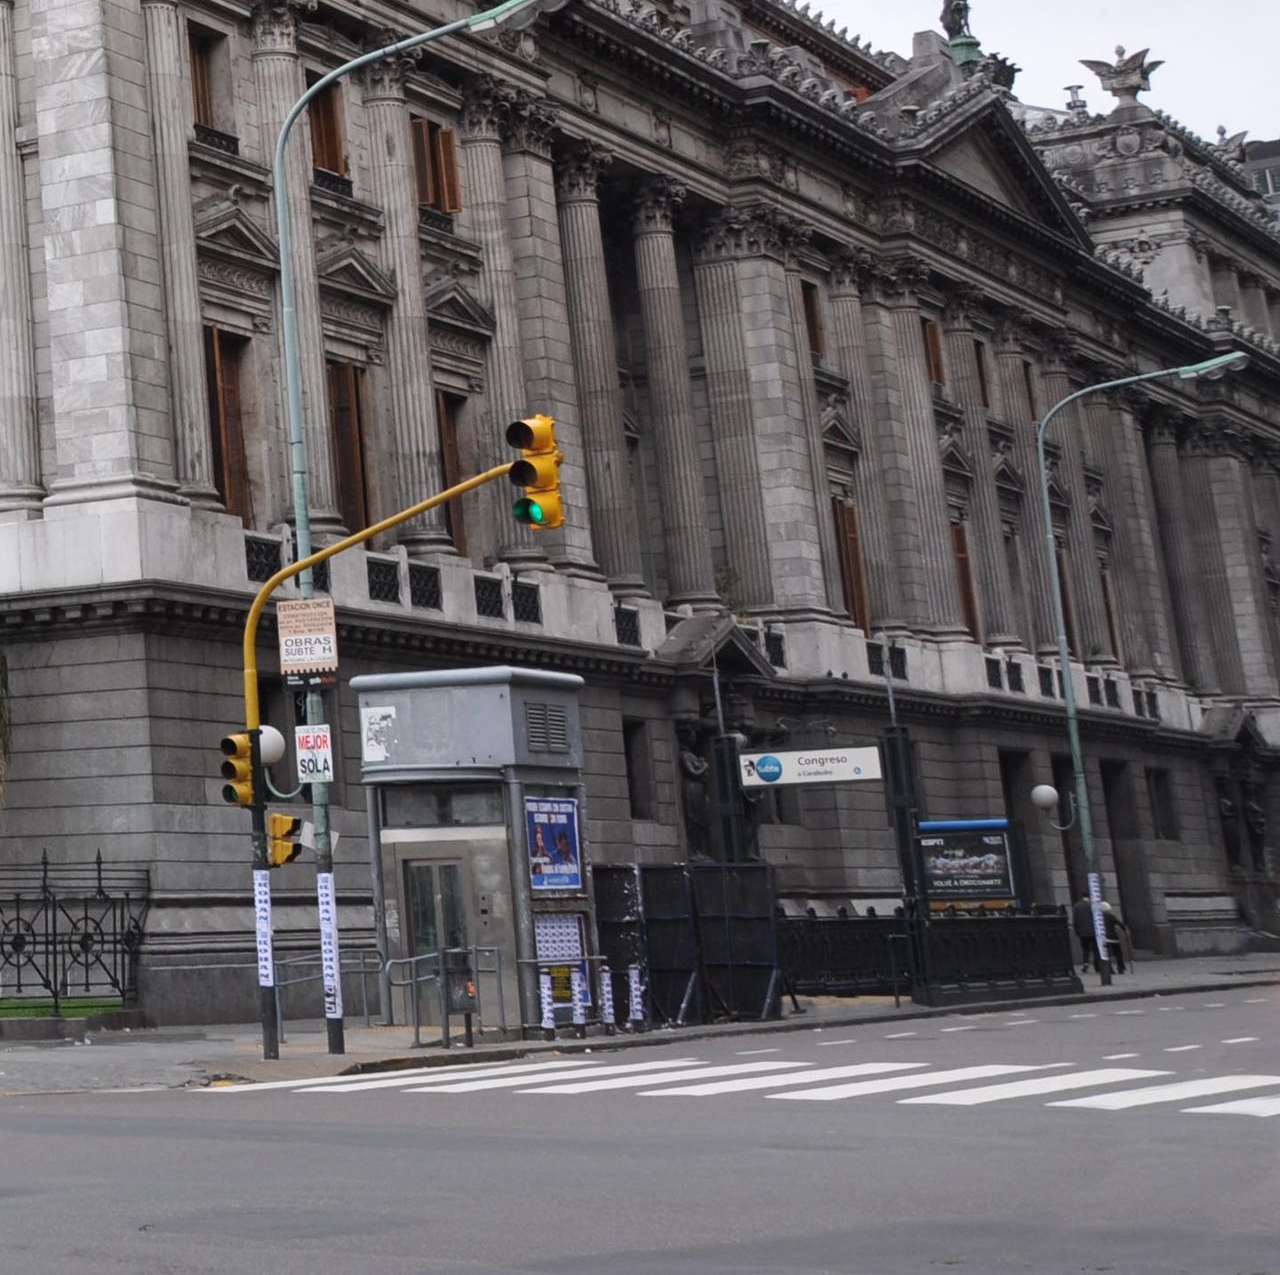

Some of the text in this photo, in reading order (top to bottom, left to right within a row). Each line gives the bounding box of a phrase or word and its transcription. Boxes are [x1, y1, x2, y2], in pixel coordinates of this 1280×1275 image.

[284, 636, 332, 648] OBRAS
[284, 645, 332, 656] SUBTE H
[298, 734, 329, 750] MEJOR
[300, 757, 330, 774] SOLA
[797, 755, 848, 767] Congreso
[921, 838, 944, 846] ESPN
